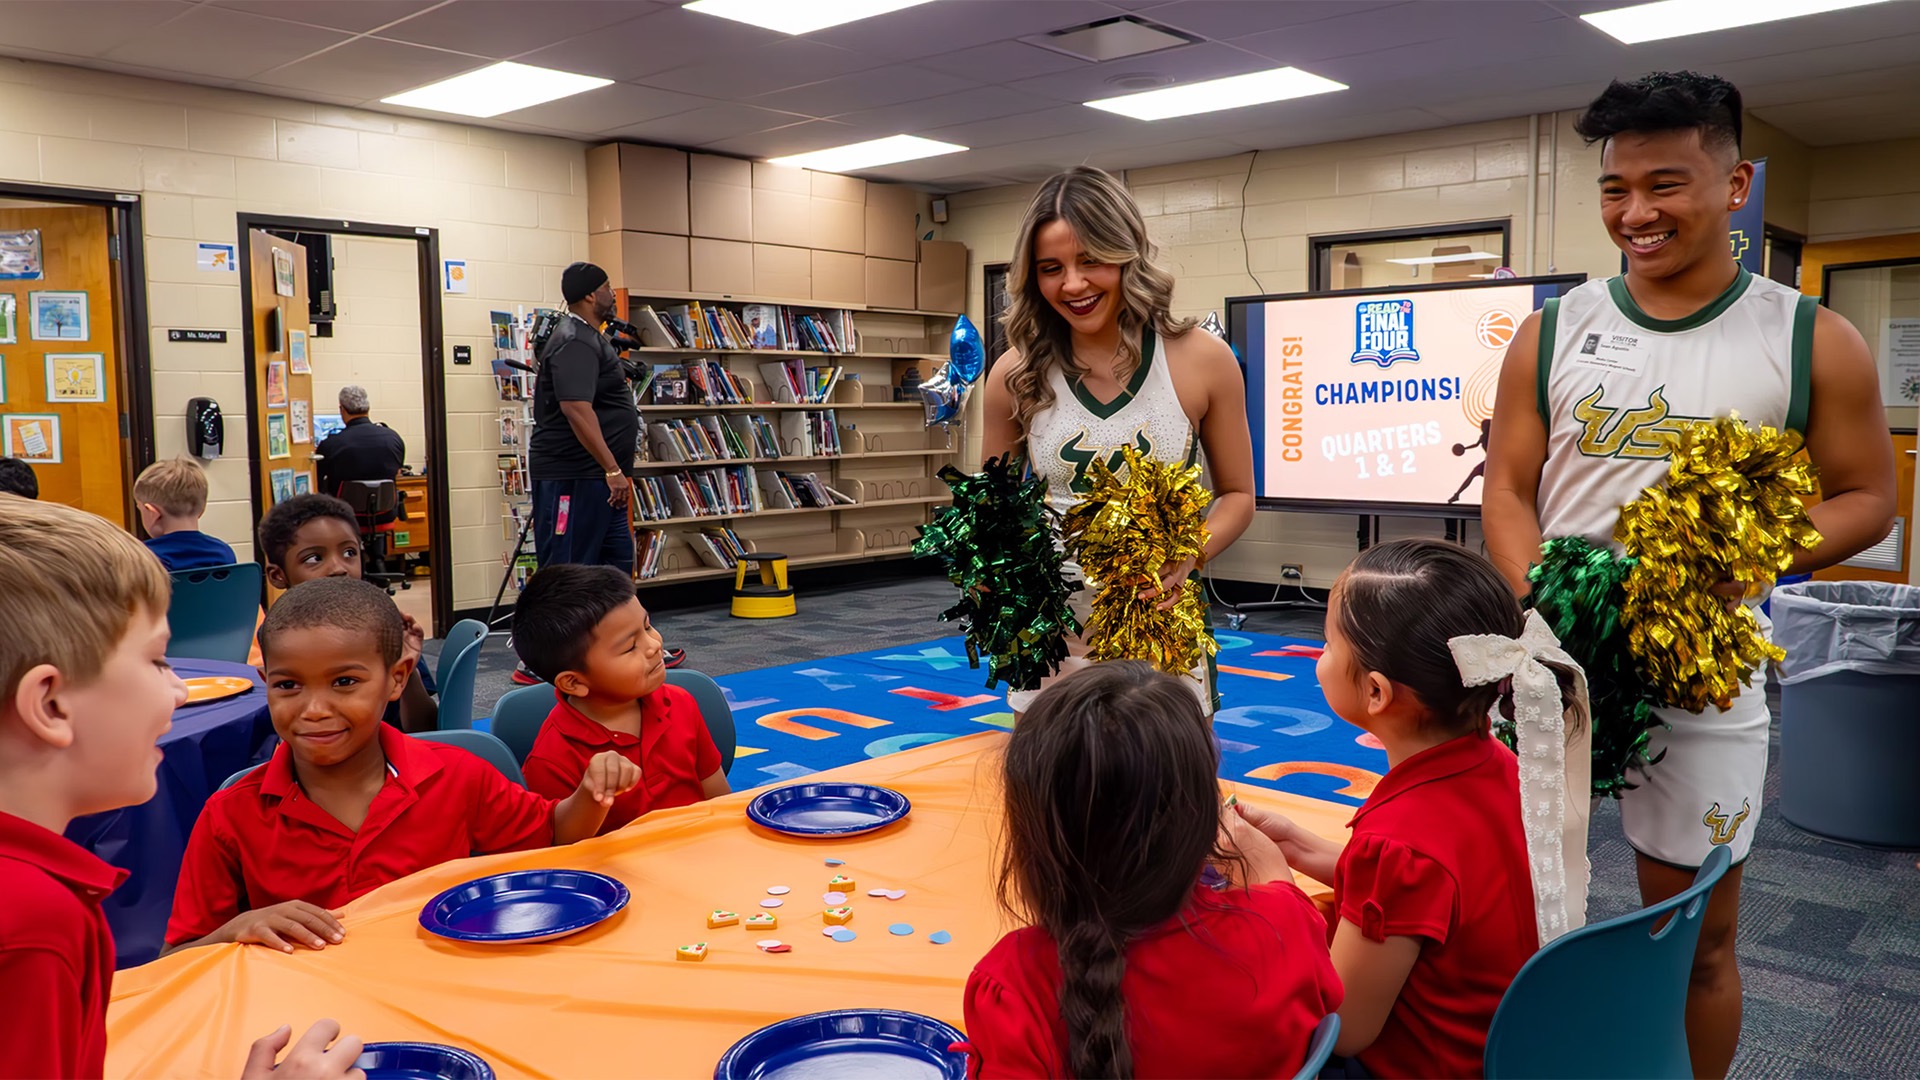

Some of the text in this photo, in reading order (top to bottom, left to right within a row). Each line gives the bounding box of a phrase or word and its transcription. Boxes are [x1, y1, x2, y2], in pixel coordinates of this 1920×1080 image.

[1367, 302, 1400, 314] READ
[1361, 312, 1409, 332] FINAL
[1361, 331, 1409, 351] FOUR
[1612, 335, 1638, 344] VISITOR
[1282, 336, 1303, 462] CONGRATS!
[1315, 377, 1460, 406] CHAMPIONS!
[1321, 420, 1442, 462] QUARTERS
[1355, 449, 1417, 479] 1 & 2
